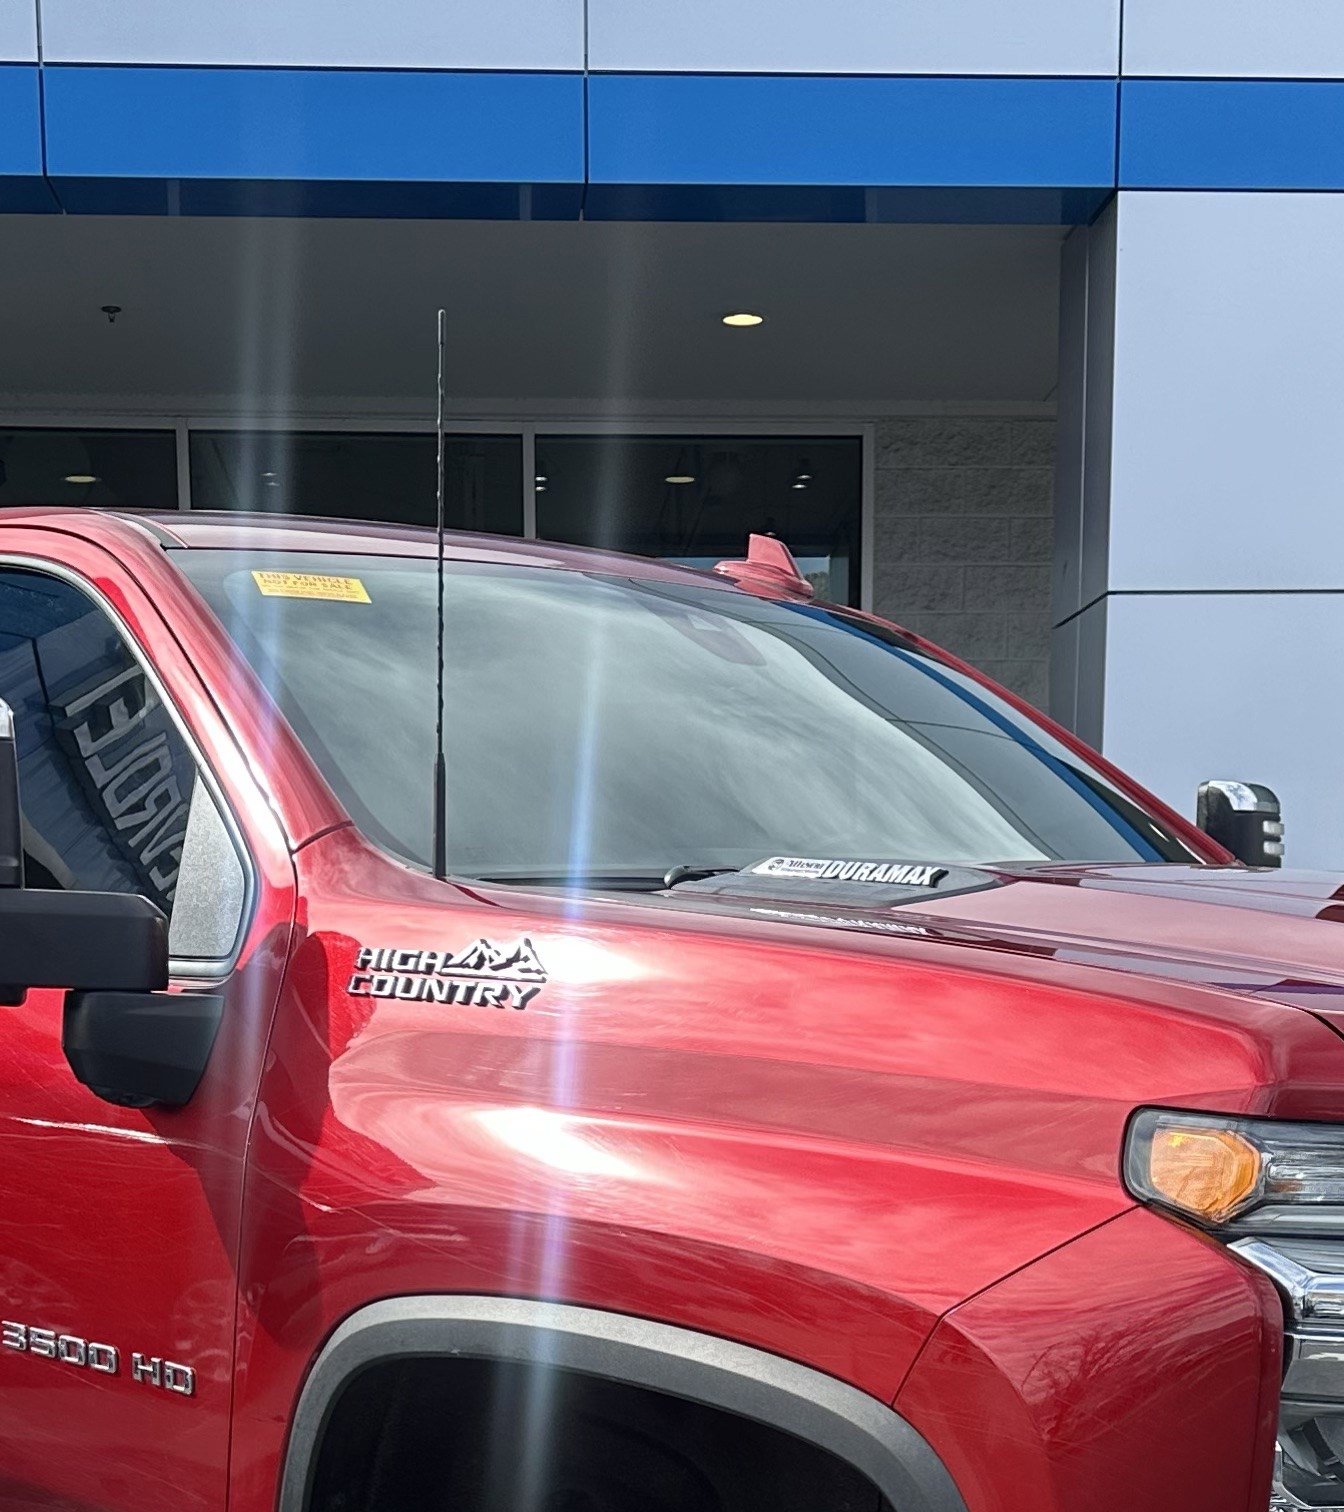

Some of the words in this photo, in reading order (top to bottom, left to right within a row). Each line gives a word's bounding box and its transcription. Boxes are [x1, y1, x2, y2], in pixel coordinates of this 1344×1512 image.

[822, 859, 944, 887] DURAMAX
[355, 947, 452, 976] HIGH
[347, 974, 542, 1010] COUNTRY
[1, 1320, 120, 1375] 3500
[131, 1352, 197, 1396] HD
